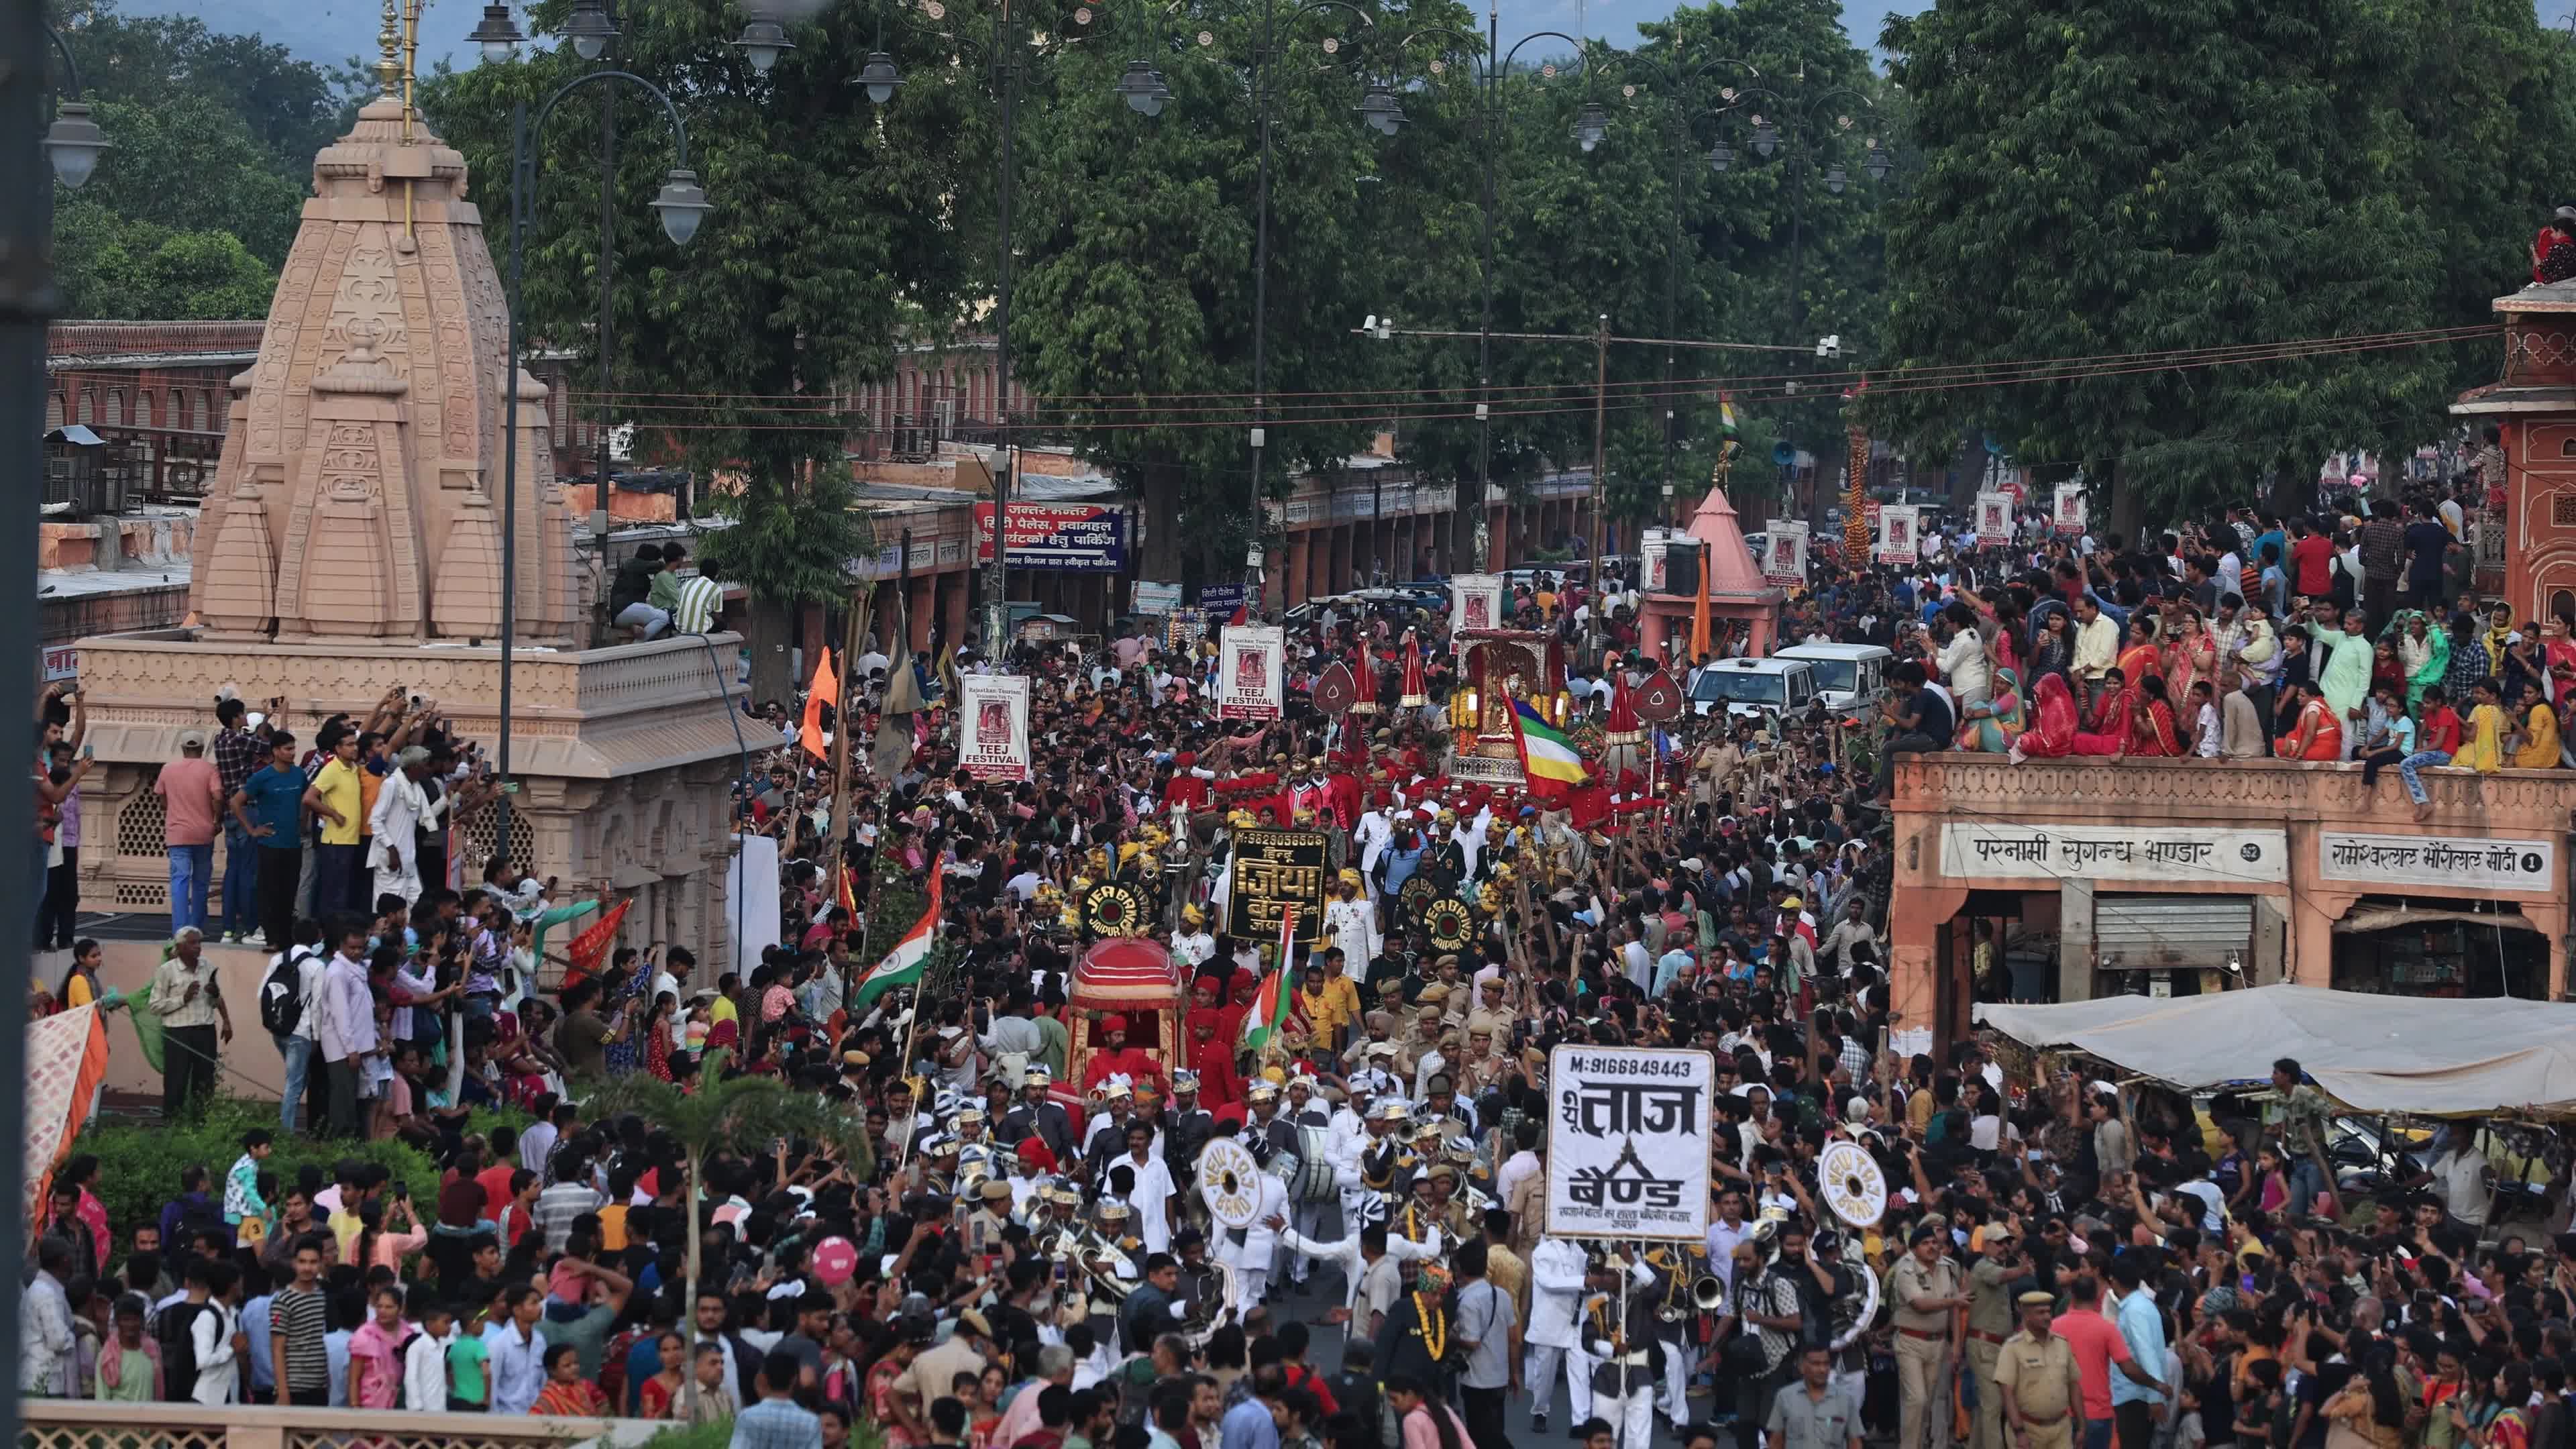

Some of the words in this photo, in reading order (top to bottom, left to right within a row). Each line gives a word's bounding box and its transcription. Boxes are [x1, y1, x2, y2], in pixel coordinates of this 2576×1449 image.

[1004, 531, 1044, 543] र्यटकों
[1226, 696, 1274, 705] FESTIVAL
[1238, 688, 1264, 697] TEEJ
[966, 755, 1020, 763] FESTIVAL
[978, 745, 1008, 754] TEEJ
[1973, 833, 2050, 865] परनामी
[2061, 840, 2134, 871] सुगन्ध
[2145, 840, 2214, 865] भण्डार
[2332, 839, 2419, 870] रामेश्वरलाल
[1087, 885, 1115, 914] JEA
[1089, 918, 1120, 937] JAIPUR
[1424, 900, 1447, 934] JEA
[1448, 899, 1471, 942] BAND
[1431, 936, 1463, 951] JAIPUR
[1570, 1056, 1690, 1077] M:9166849443
[1579, 1079, 1704, 1140] ताज
[1206, 1147, 1226, 1187] NEW
[1829, 1150, 1852, 1186] NEW
[1216, 1195, 1252, 1218] BAND
[1836, 1195, 1876, 1220] BAND
